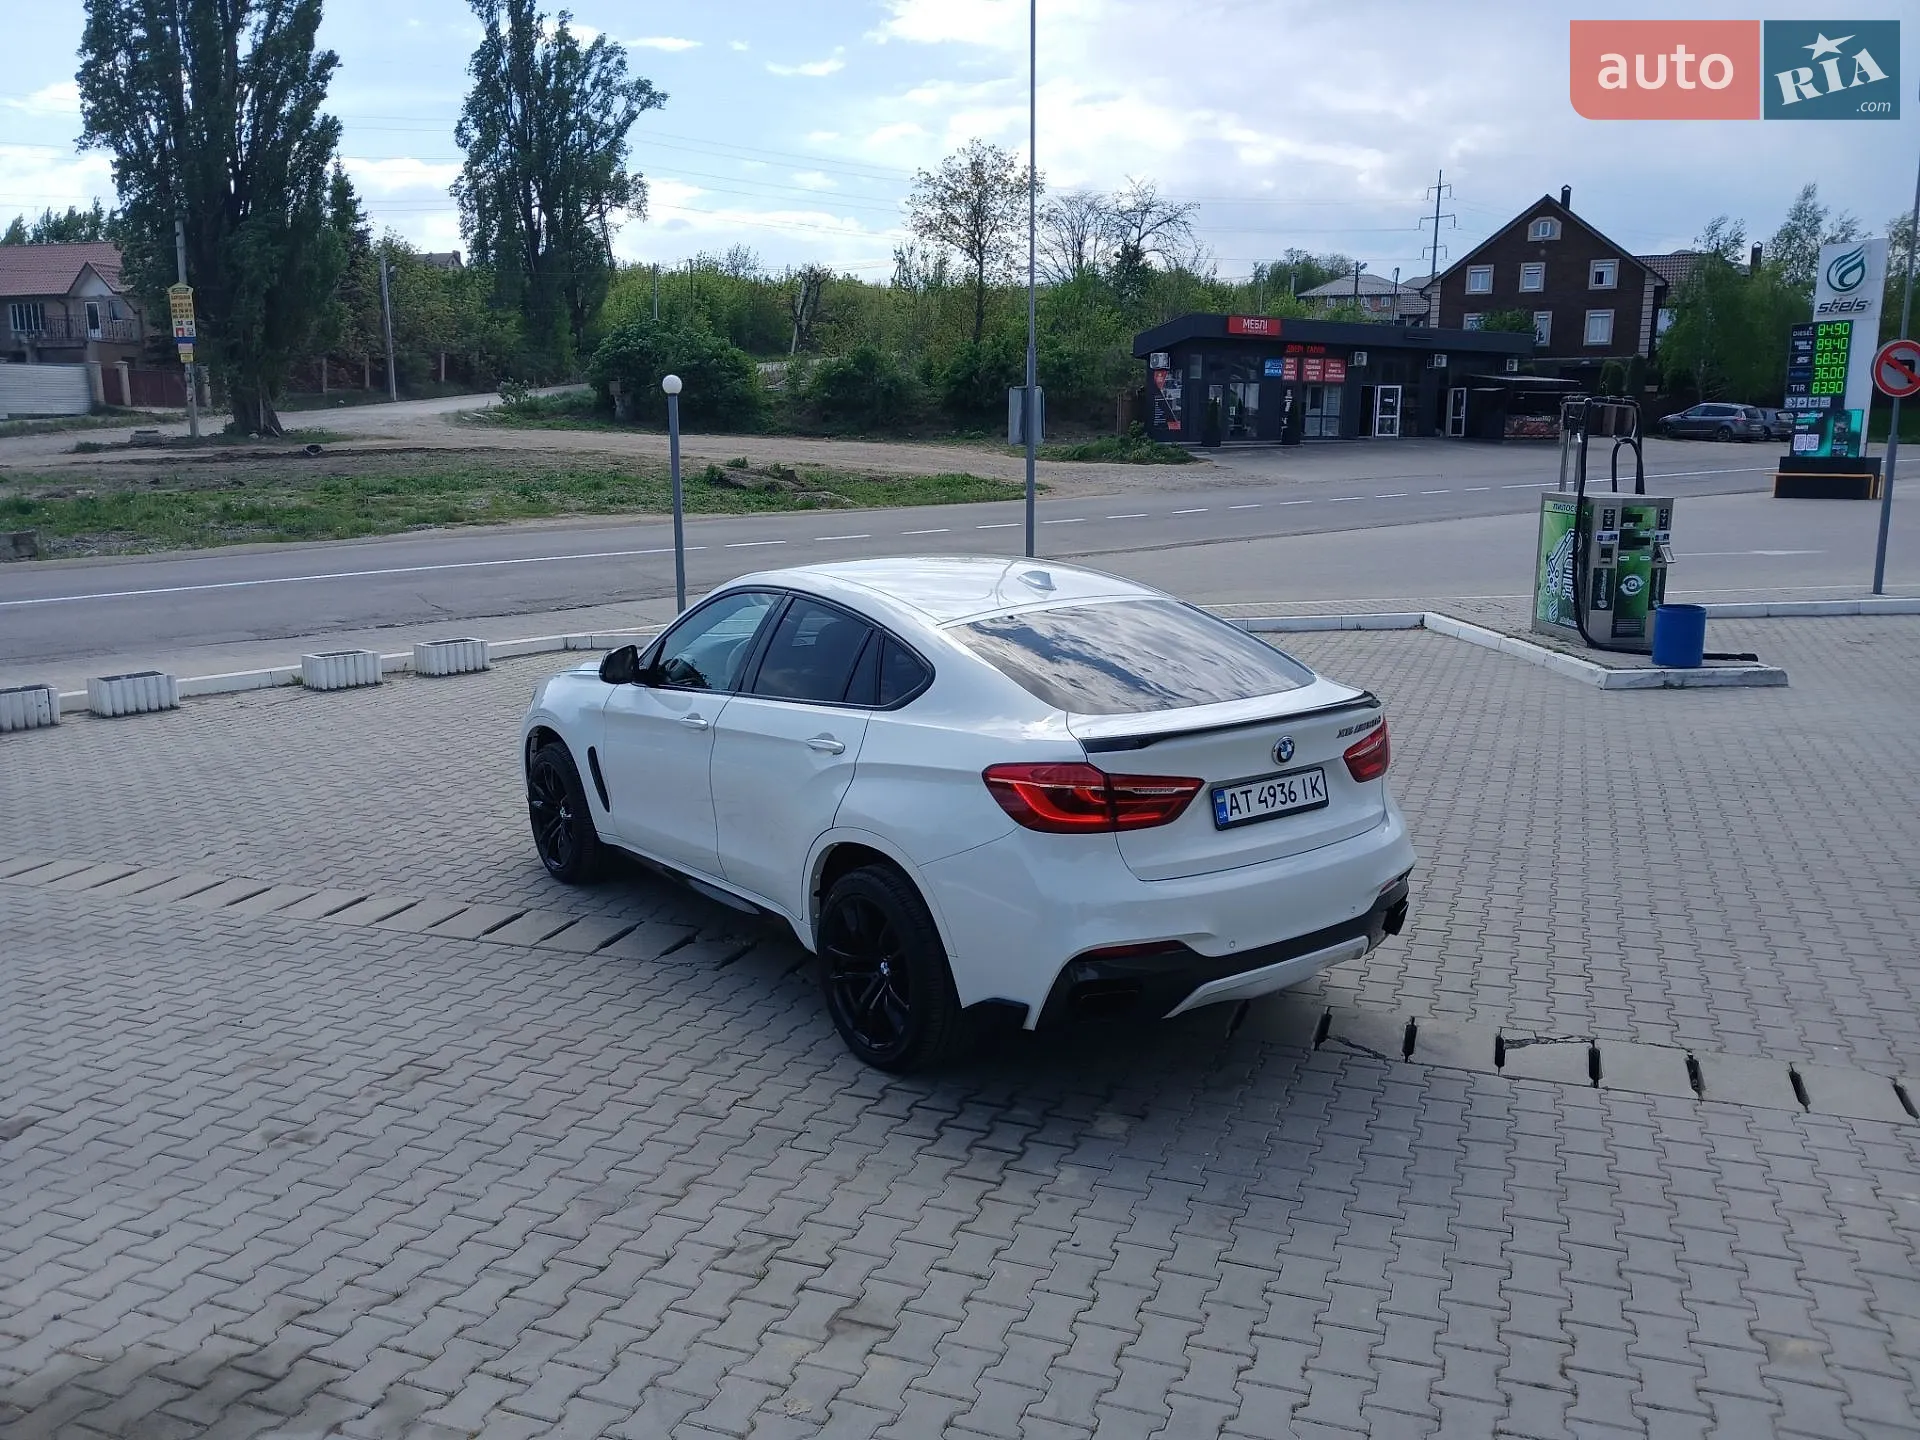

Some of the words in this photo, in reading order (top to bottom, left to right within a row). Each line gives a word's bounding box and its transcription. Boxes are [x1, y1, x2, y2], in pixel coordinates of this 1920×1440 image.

[1817, 298, 1869, 313] stels
[1242, 319, 1268, 330] МЕБЛІ
[1791, 384, 1806, 393] TIR
[1229, 789, 1253, 816] AT
[1258, 780, 1297, 809] 4936
[1302, 775, 1323, 800] IK
